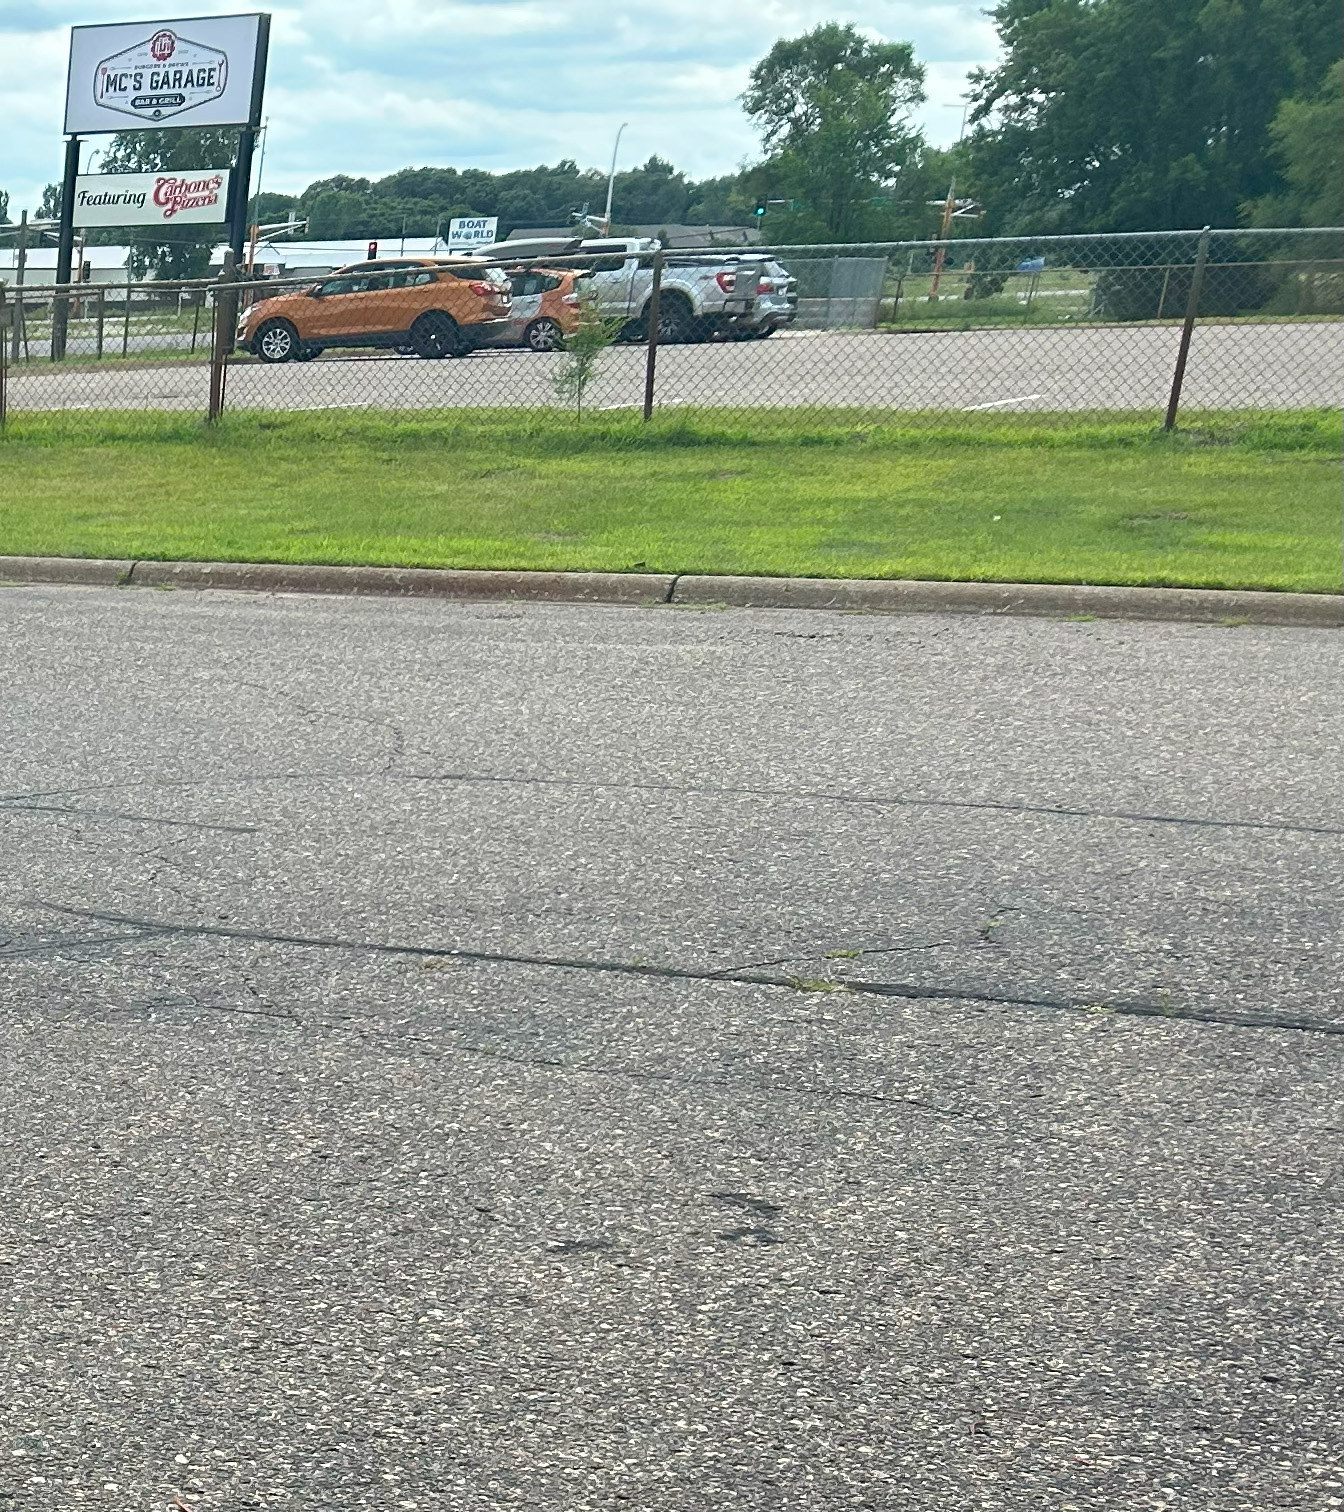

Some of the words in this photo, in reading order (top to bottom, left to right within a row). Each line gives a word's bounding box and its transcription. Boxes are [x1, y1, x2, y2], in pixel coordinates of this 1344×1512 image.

[105, 72, 144, 93] MC'S
[149, 67, 217, 90] GARAGE
[134, 97, 150, 106] BAR
[158, 95, 182, 104] GRILL
[77, 189, 147, 209] Featuring
[459, 220, 488, 229] BOAT
